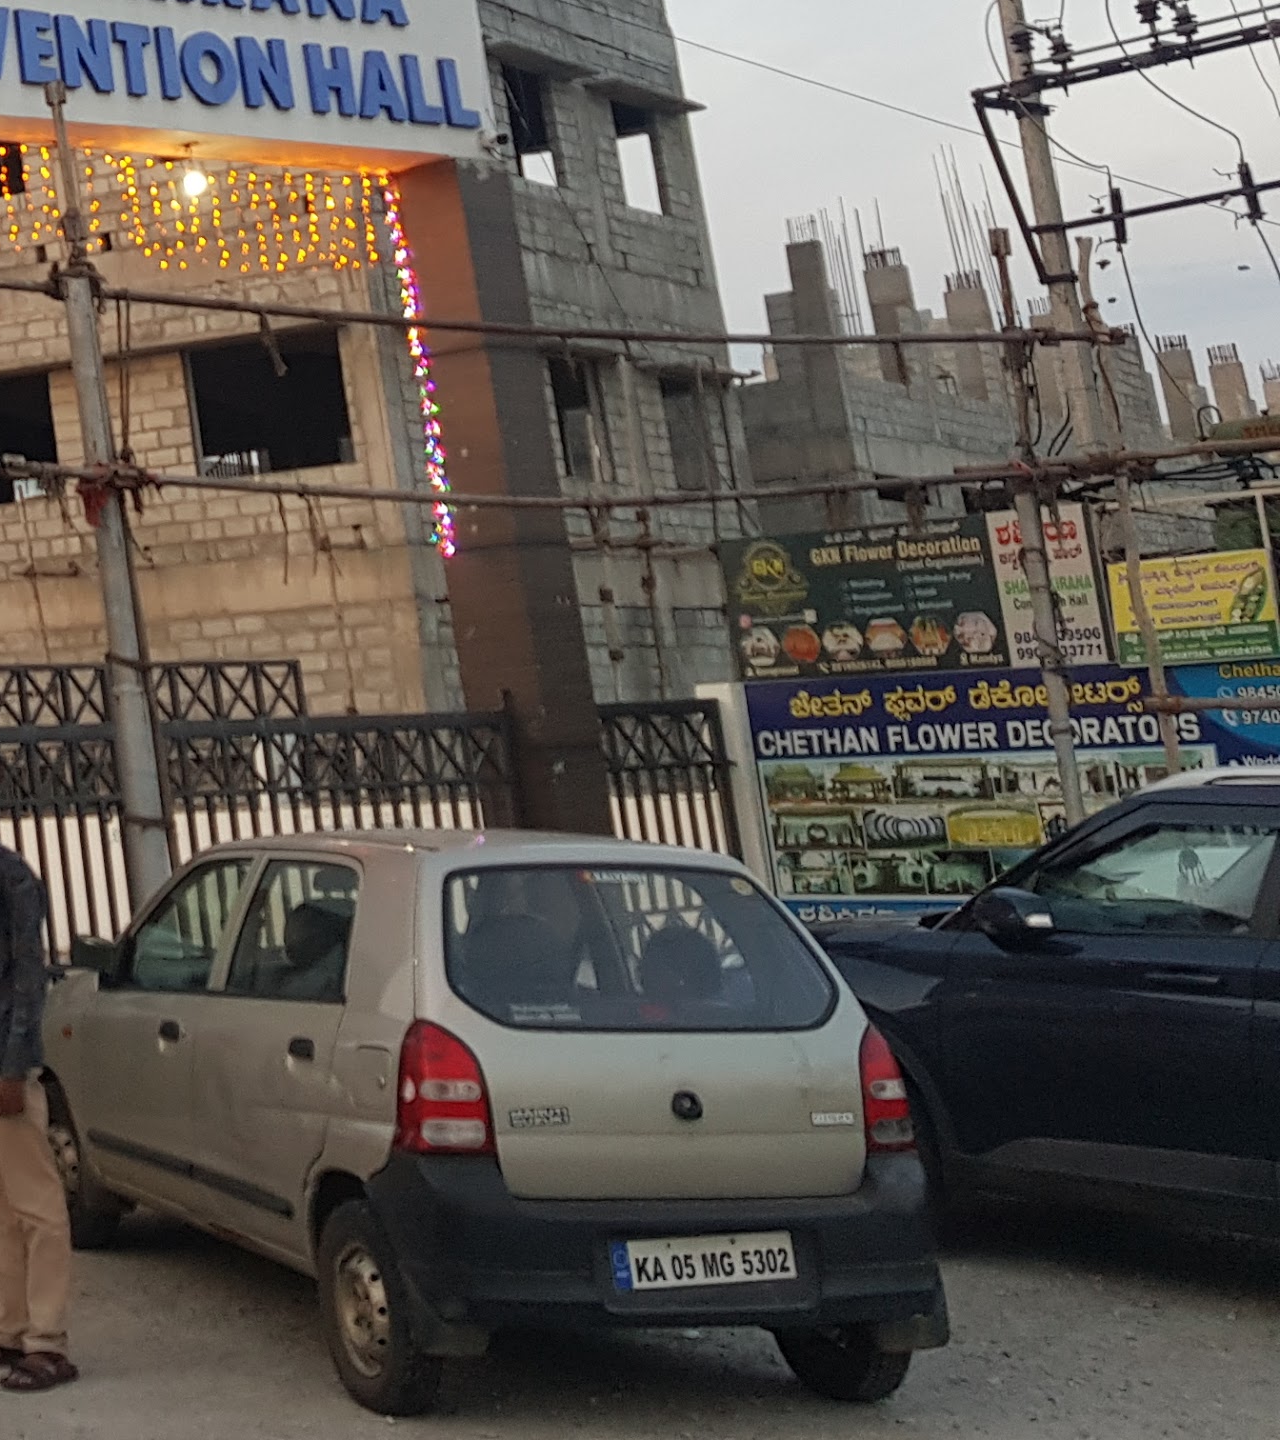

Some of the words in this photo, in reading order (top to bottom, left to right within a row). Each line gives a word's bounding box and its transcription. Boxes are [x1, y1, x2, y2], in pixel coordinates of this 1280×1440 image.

[302, 42, 481, 128] HALL
[844, 542, 893, 562] Flower
[897, 536, 981, 557] Decoration
[1004, 573, 1093, 595] SHAIRANA
[1017, 645, 1103, 660] 9933771
[758, 728, 880, 756] CHETHAN
[887, 721, 998, 751] FLOWER
[1007, 713, 1201, 748] DECRATOS
[635, 1256, 668, 1283] KA
[671, 1254, 697, 1280] 05
[701, 1251, 736, 1278] MG
[741, 1247, 792, 1275] 5302
